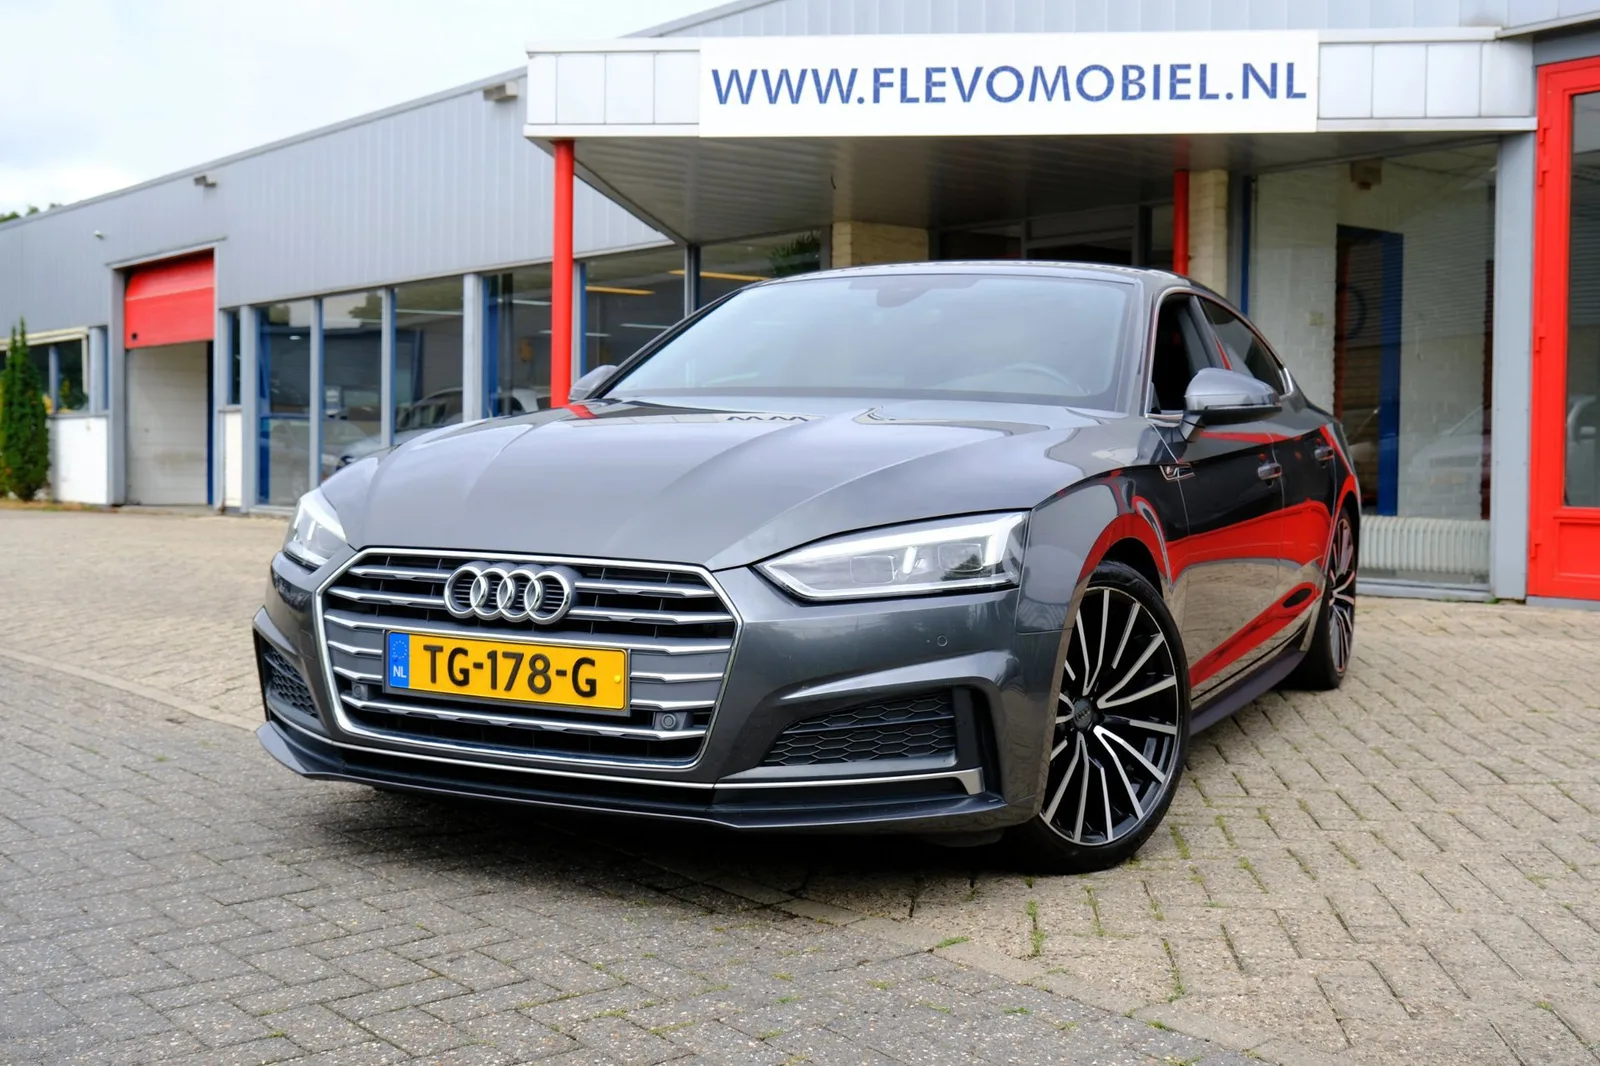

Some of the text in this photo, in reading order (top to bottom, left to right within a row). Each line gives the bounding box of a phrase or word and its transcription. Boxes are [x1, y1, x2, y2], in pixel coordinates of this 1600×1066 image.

[711, 62, 1307, 105] WWW.FLEVOMOBIEL.NL
[392, 665, 407, 678] NL
[423, 644, 597, 698] TG-178-G
